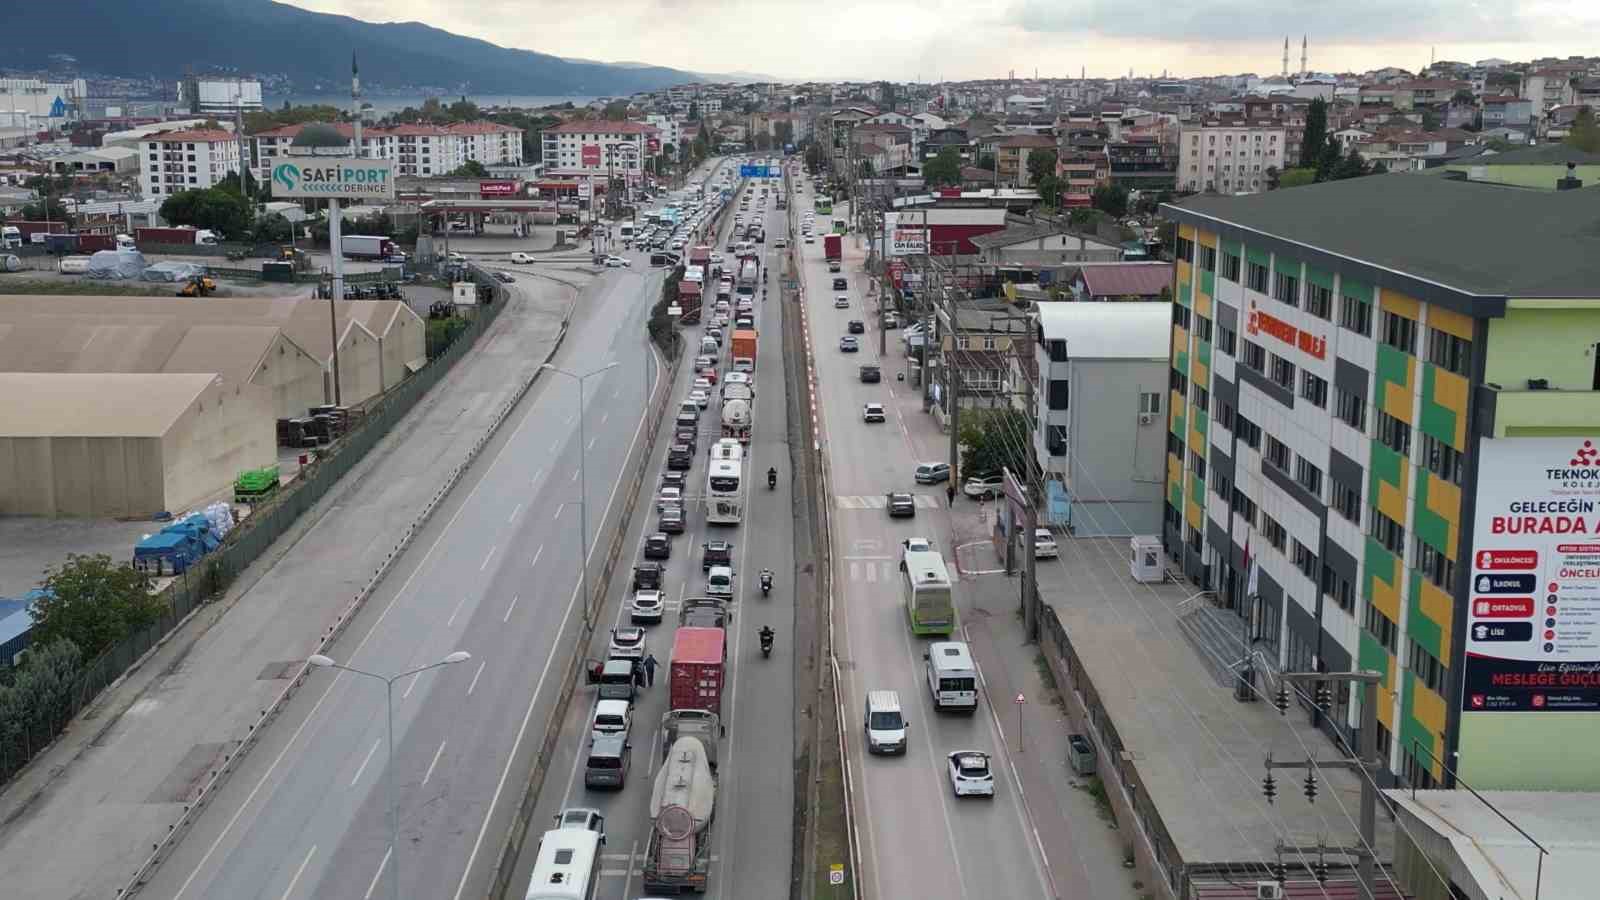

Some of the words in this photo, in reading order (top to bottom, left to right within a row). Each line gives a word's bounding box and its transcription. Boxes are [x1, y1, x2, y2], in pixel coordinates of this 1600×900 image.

[1546, 469, 1600, 480] TEKNOK
[1510, 498, 1593, 513] GELECEĞİN
[1492, 516, 1587, 534] BURADA
